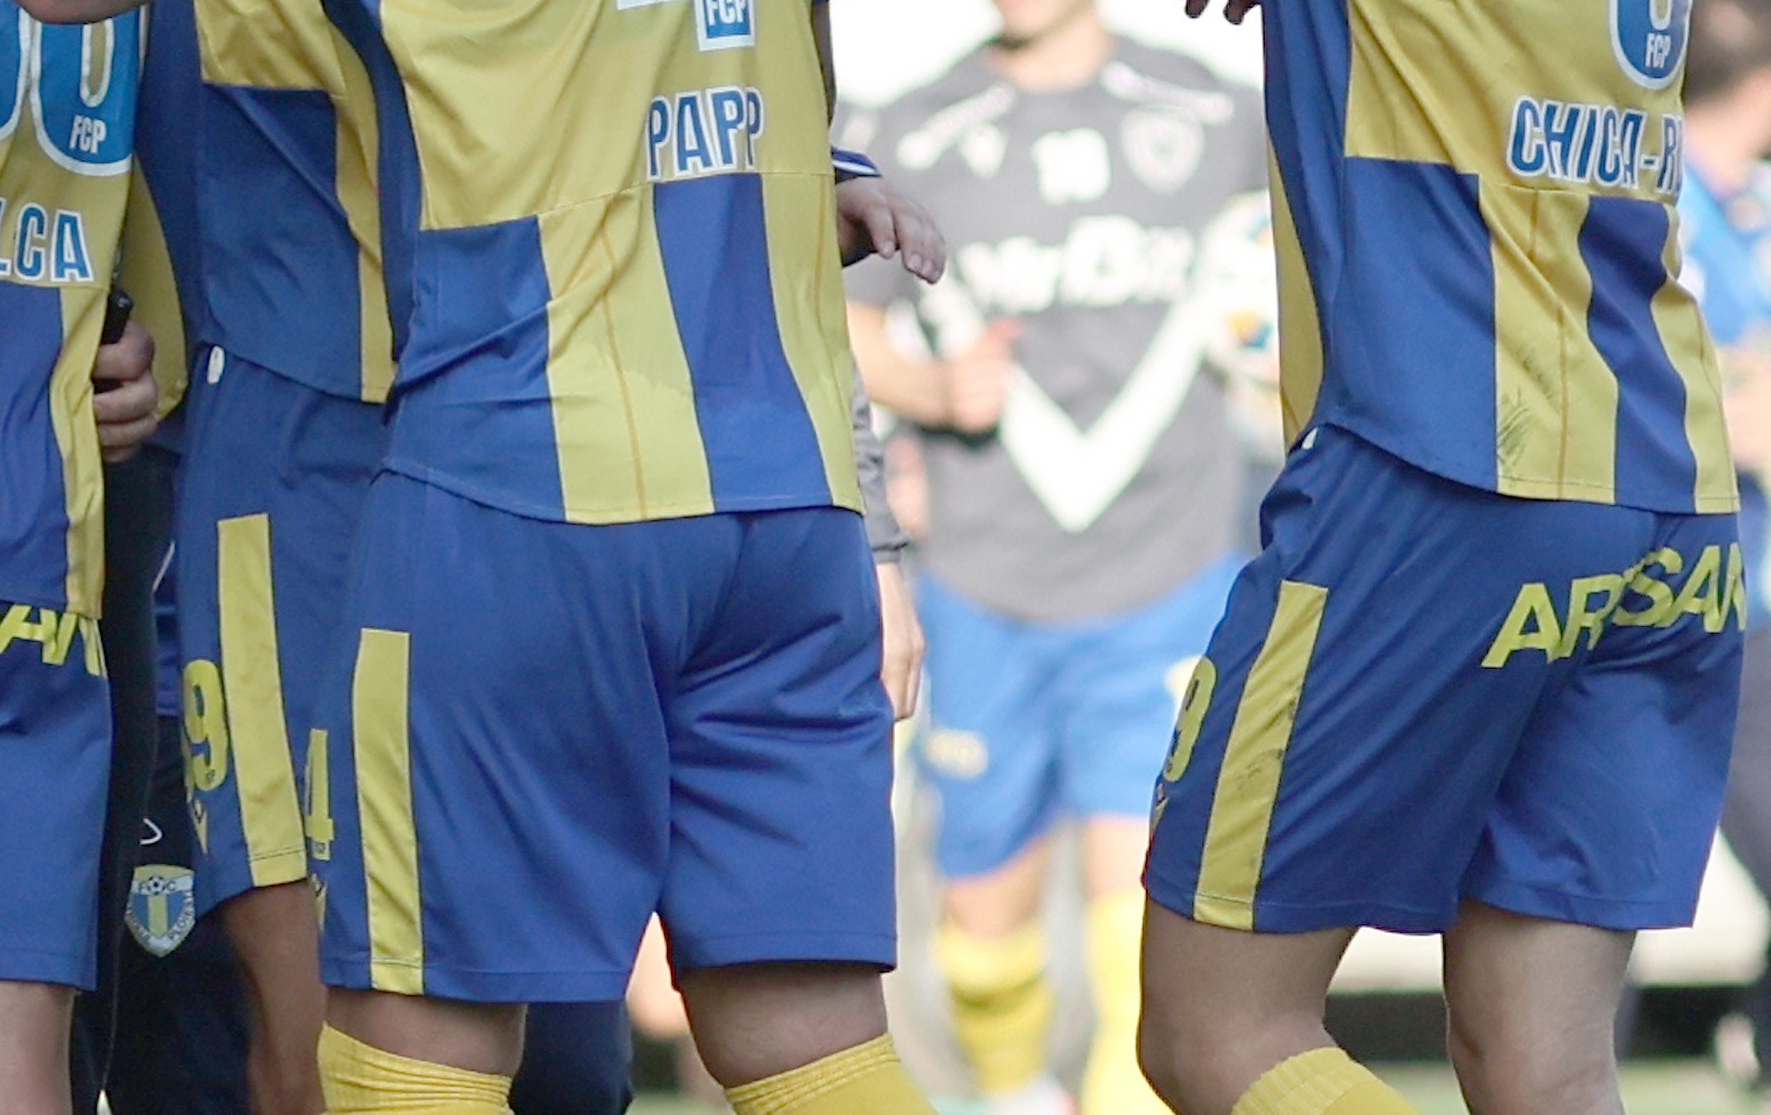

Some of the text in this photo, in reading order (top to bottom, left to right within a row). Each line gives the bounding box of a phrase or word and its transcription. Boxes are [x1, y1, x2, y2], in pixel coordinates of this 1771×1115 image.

[1645, 32, 1672, 69] FCP
[69, 104, 108, 154] FCP
[646, 85, 764, 182] PAPP
[1507, 95, 1684, 195] CHICA-R
